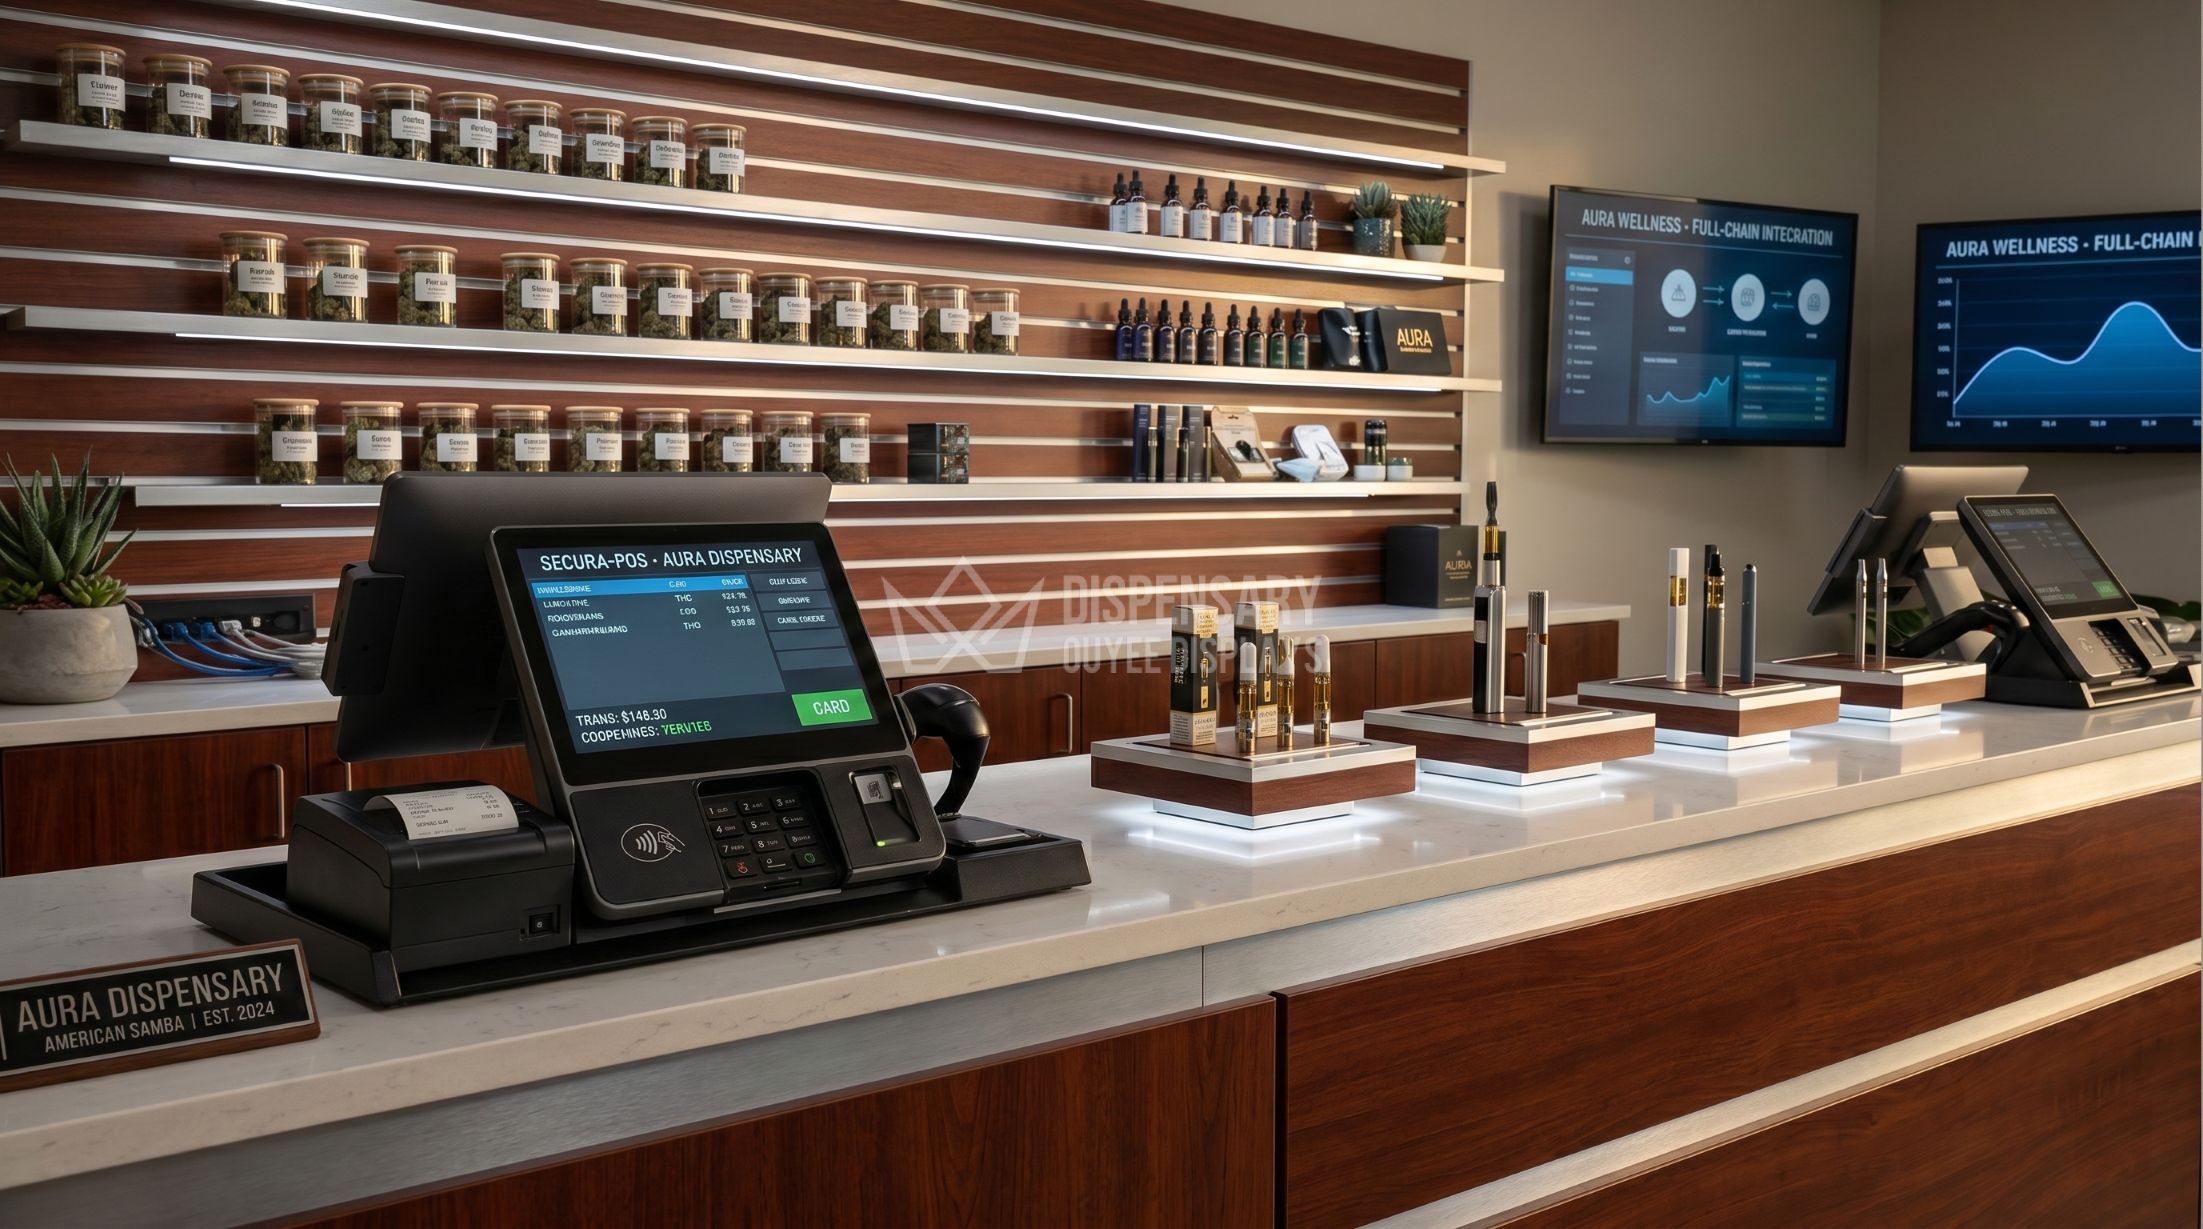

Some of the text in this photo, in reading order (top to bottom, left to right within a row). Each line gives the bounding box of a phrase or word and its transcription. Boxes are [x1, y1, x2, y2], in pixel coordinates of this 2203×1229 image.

[1582, 209, 1615, 228] AURA
[1617, 212, 1682, 233] WELLNESS
[1692, 218, 1760, 240] FULL-CHAIN
[1946, 240, 1989, 257] AURA
[1993, 236, 2079, 256] WELLNESS
[2094, 231, 2193, 252] FULL-CHAIN
[1397, 328, 1433, 347] AURA
[540, 547, 802, 571] SECURA-POS AURA DISPENSARY
[813, 699, 850, 716] CARD
[575, 712, 620, 727] TRANS:
[743, 803, 750, 811] 2
[776, 798, 783, 807] 3
[750, 821, 757, 829] 5
[782, 816, 789, 824] 6
[716, 825, 723, 833] 4
[722, 845, 729, 853] 7
[757, 840, 765, 848] 8
[18, 962, 283, 1032] AURA DISPENSARY
[44, 1000, 275, 1054] AMERICAN SAMBA EST. 2024
